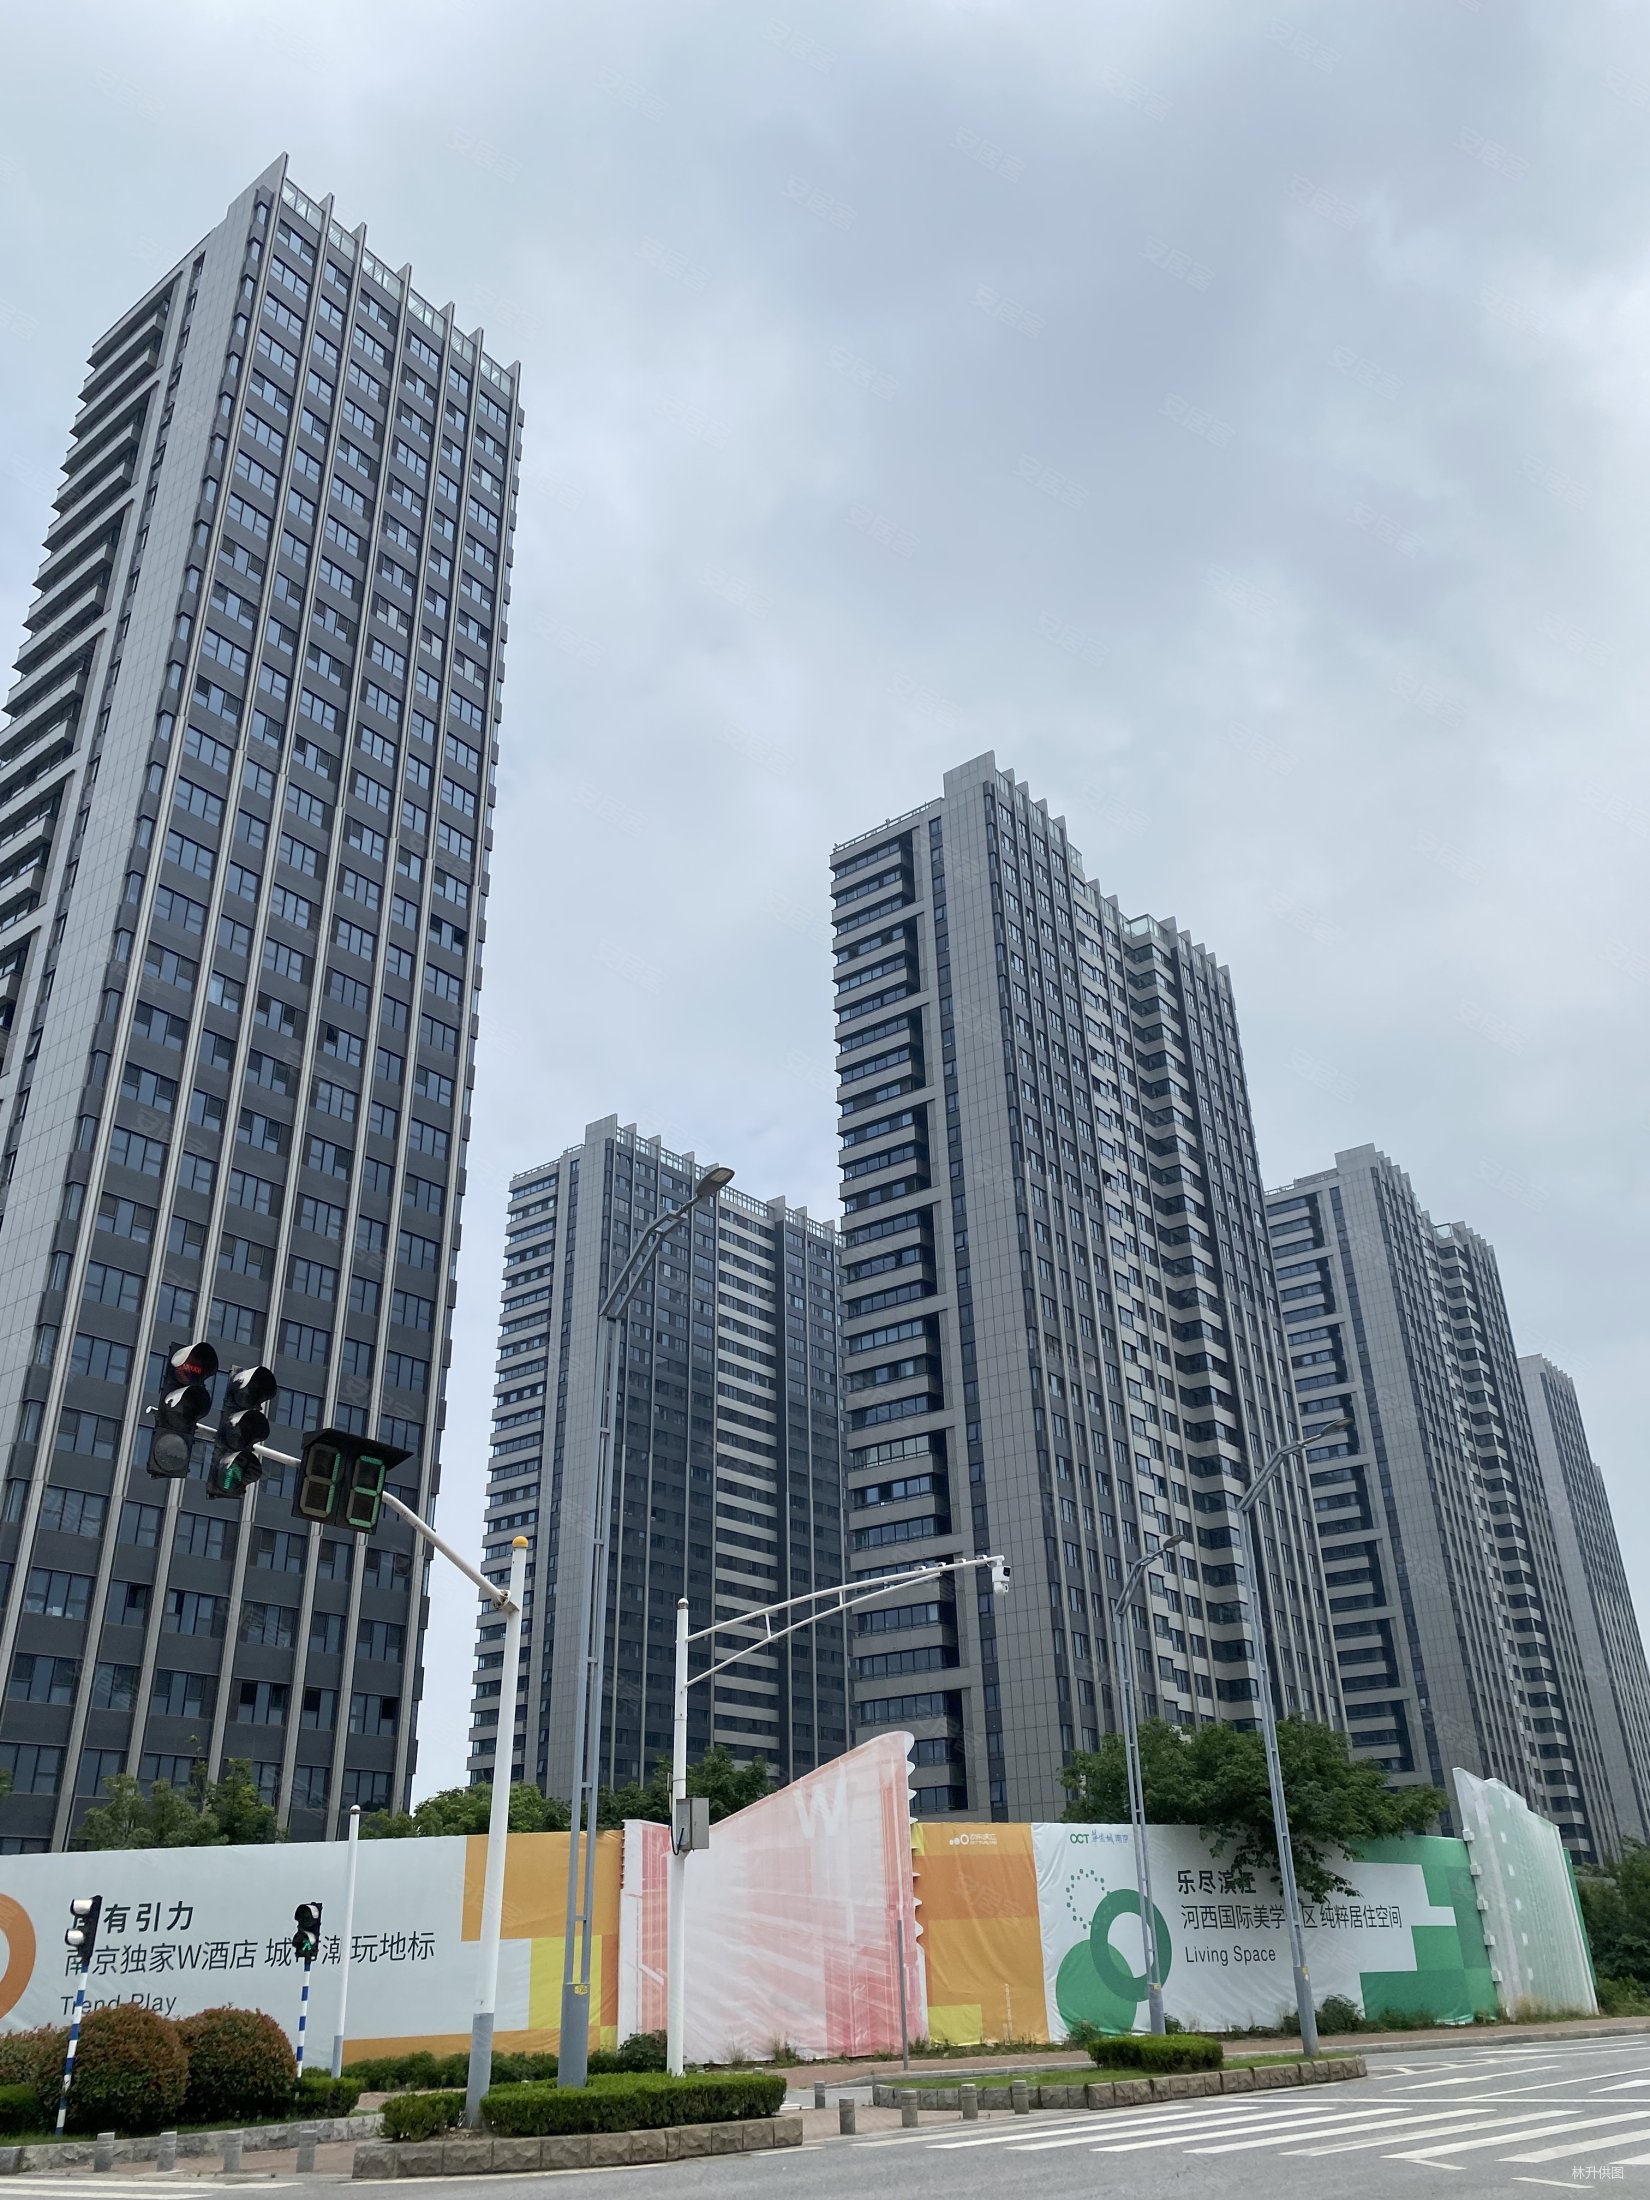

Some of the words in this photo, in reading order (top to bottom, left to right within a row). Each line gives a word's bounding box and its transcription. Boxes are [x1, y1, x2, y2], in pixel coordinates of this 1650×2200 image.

[1069, 1833, 1089, 1844] OCT
[72, 1900, 194, 1934] 有引力
[1181, 1904, 1318, 1929] 河西国际美学区
[1319, 1905, 1402, 1929] 纯粹居住空间
[264, 1930, 436, 1968] 城潮玩地标
[1184, 1946, 1229, 1967] Living
[1233, 1945, 1276, 1964] Space
[130, 1992, 177, 2017] Play
